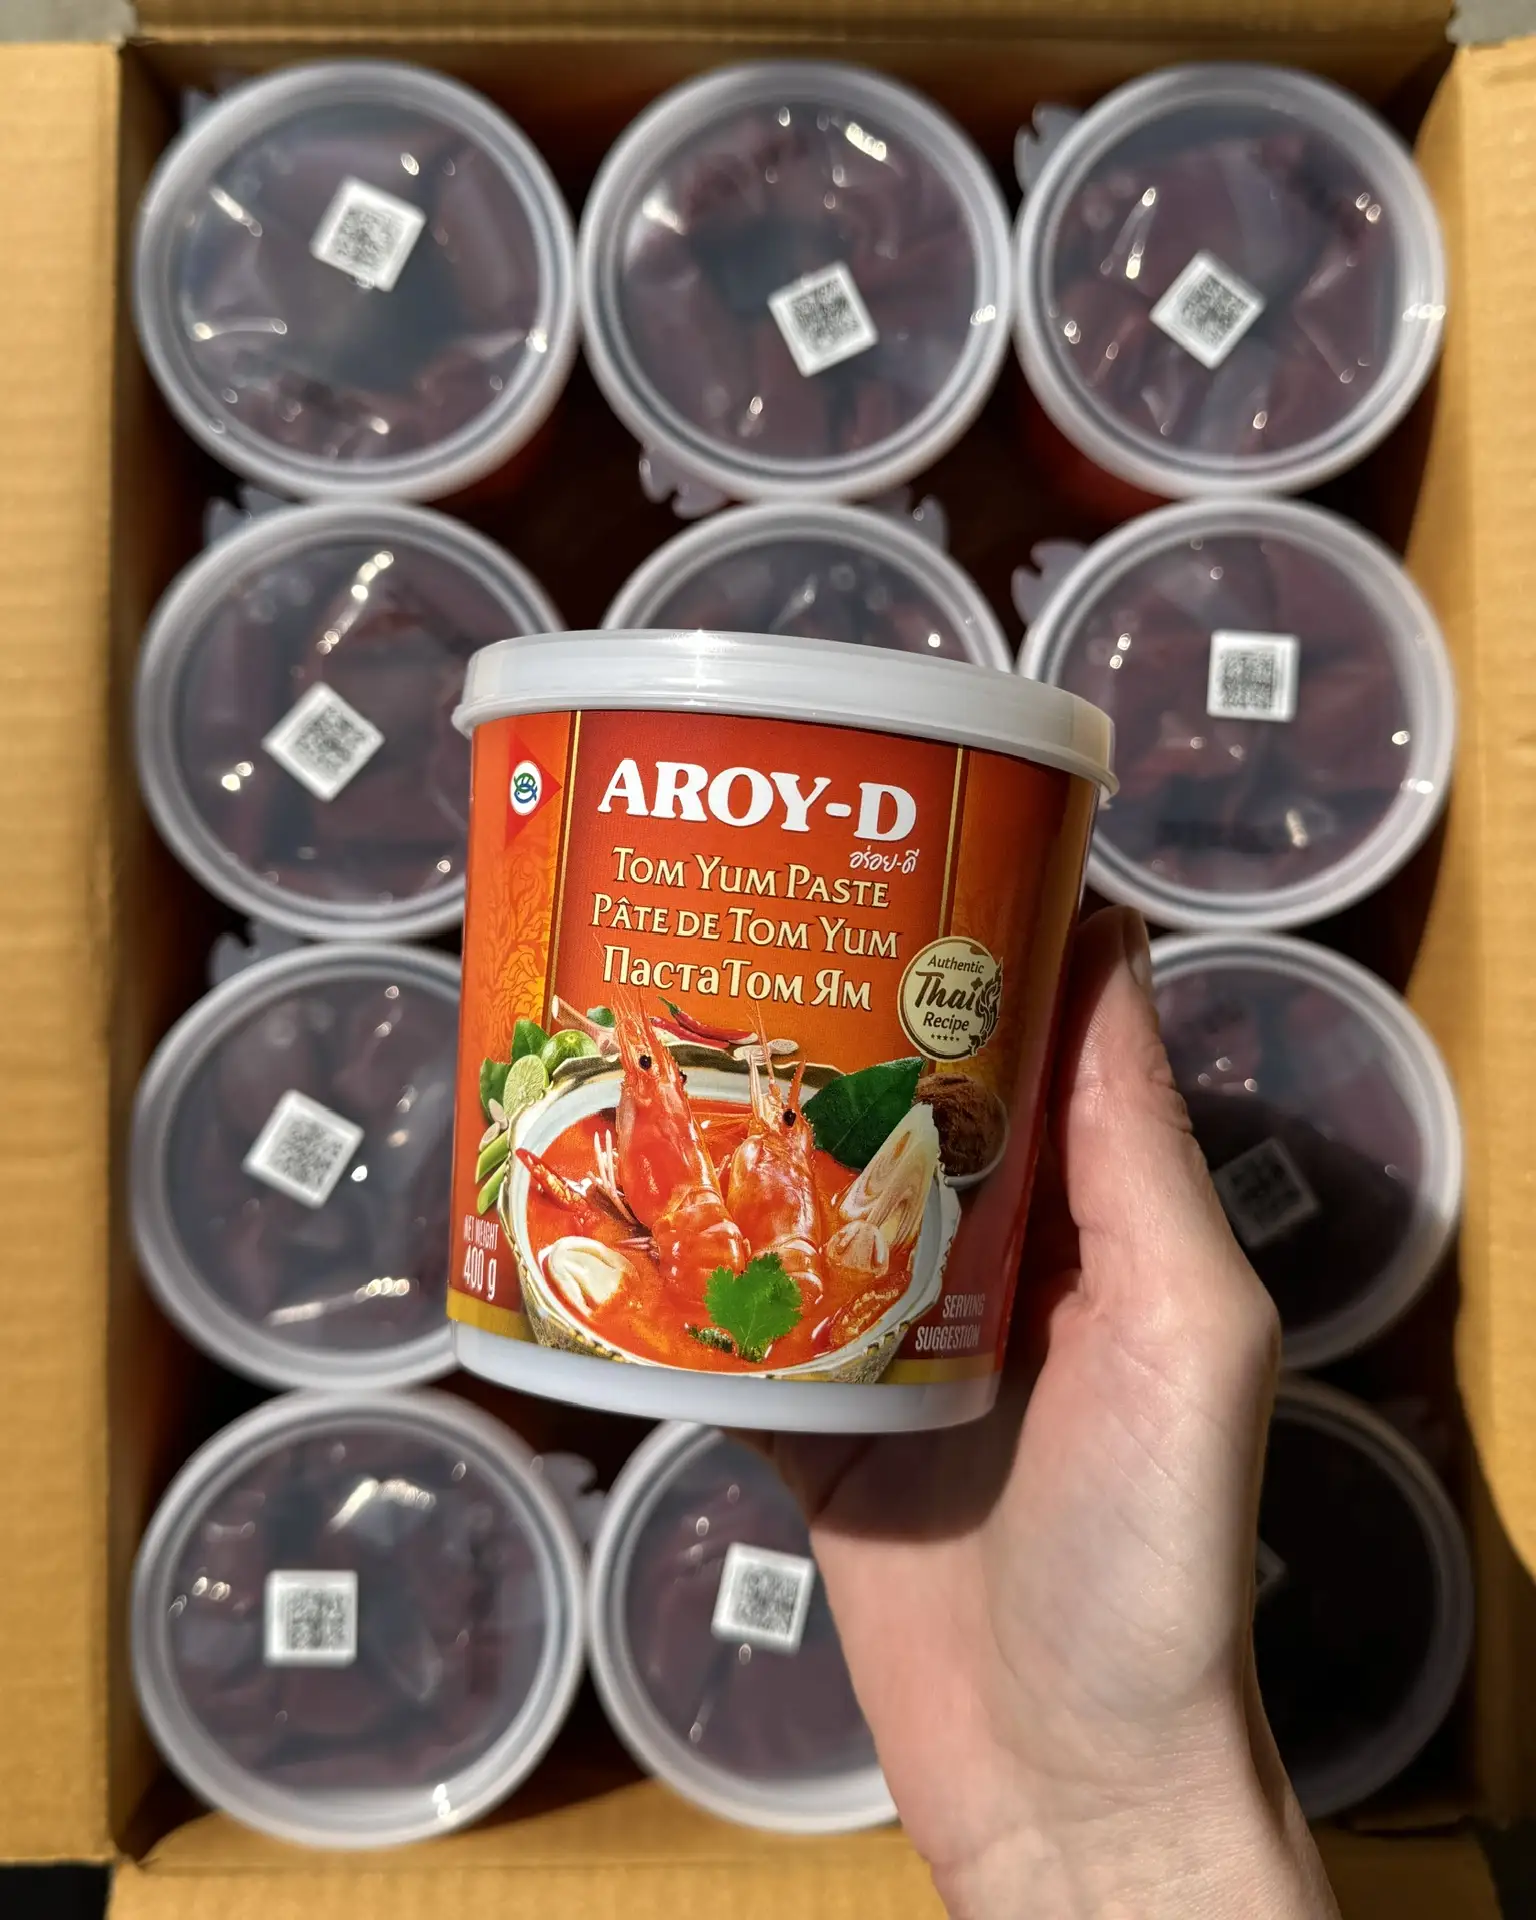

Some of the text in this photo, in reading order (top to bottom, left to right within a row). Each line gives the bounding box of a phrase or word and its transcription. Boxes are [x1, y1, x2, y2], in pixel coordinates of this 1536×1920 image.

[597, 757, 917, 842] AROY-D
[849, 845, 920, 874] อร่อย-ดี
[785, 864, 890, 908] PASTE
[603, 945, 720, 995] Паста
[927, 954, 985, 974] Authentic
[914, 970, 983, 1011] Thai
[922, 1011, 970, 1035] Recipe
[464, 1214, 499, 1251] NET WEIGHT
[463, 1244, 497, 1301] 400 g
[942, 1293, 986, 1319] SERVING
[915, 1324, 981, 1351] SUGGESTION
